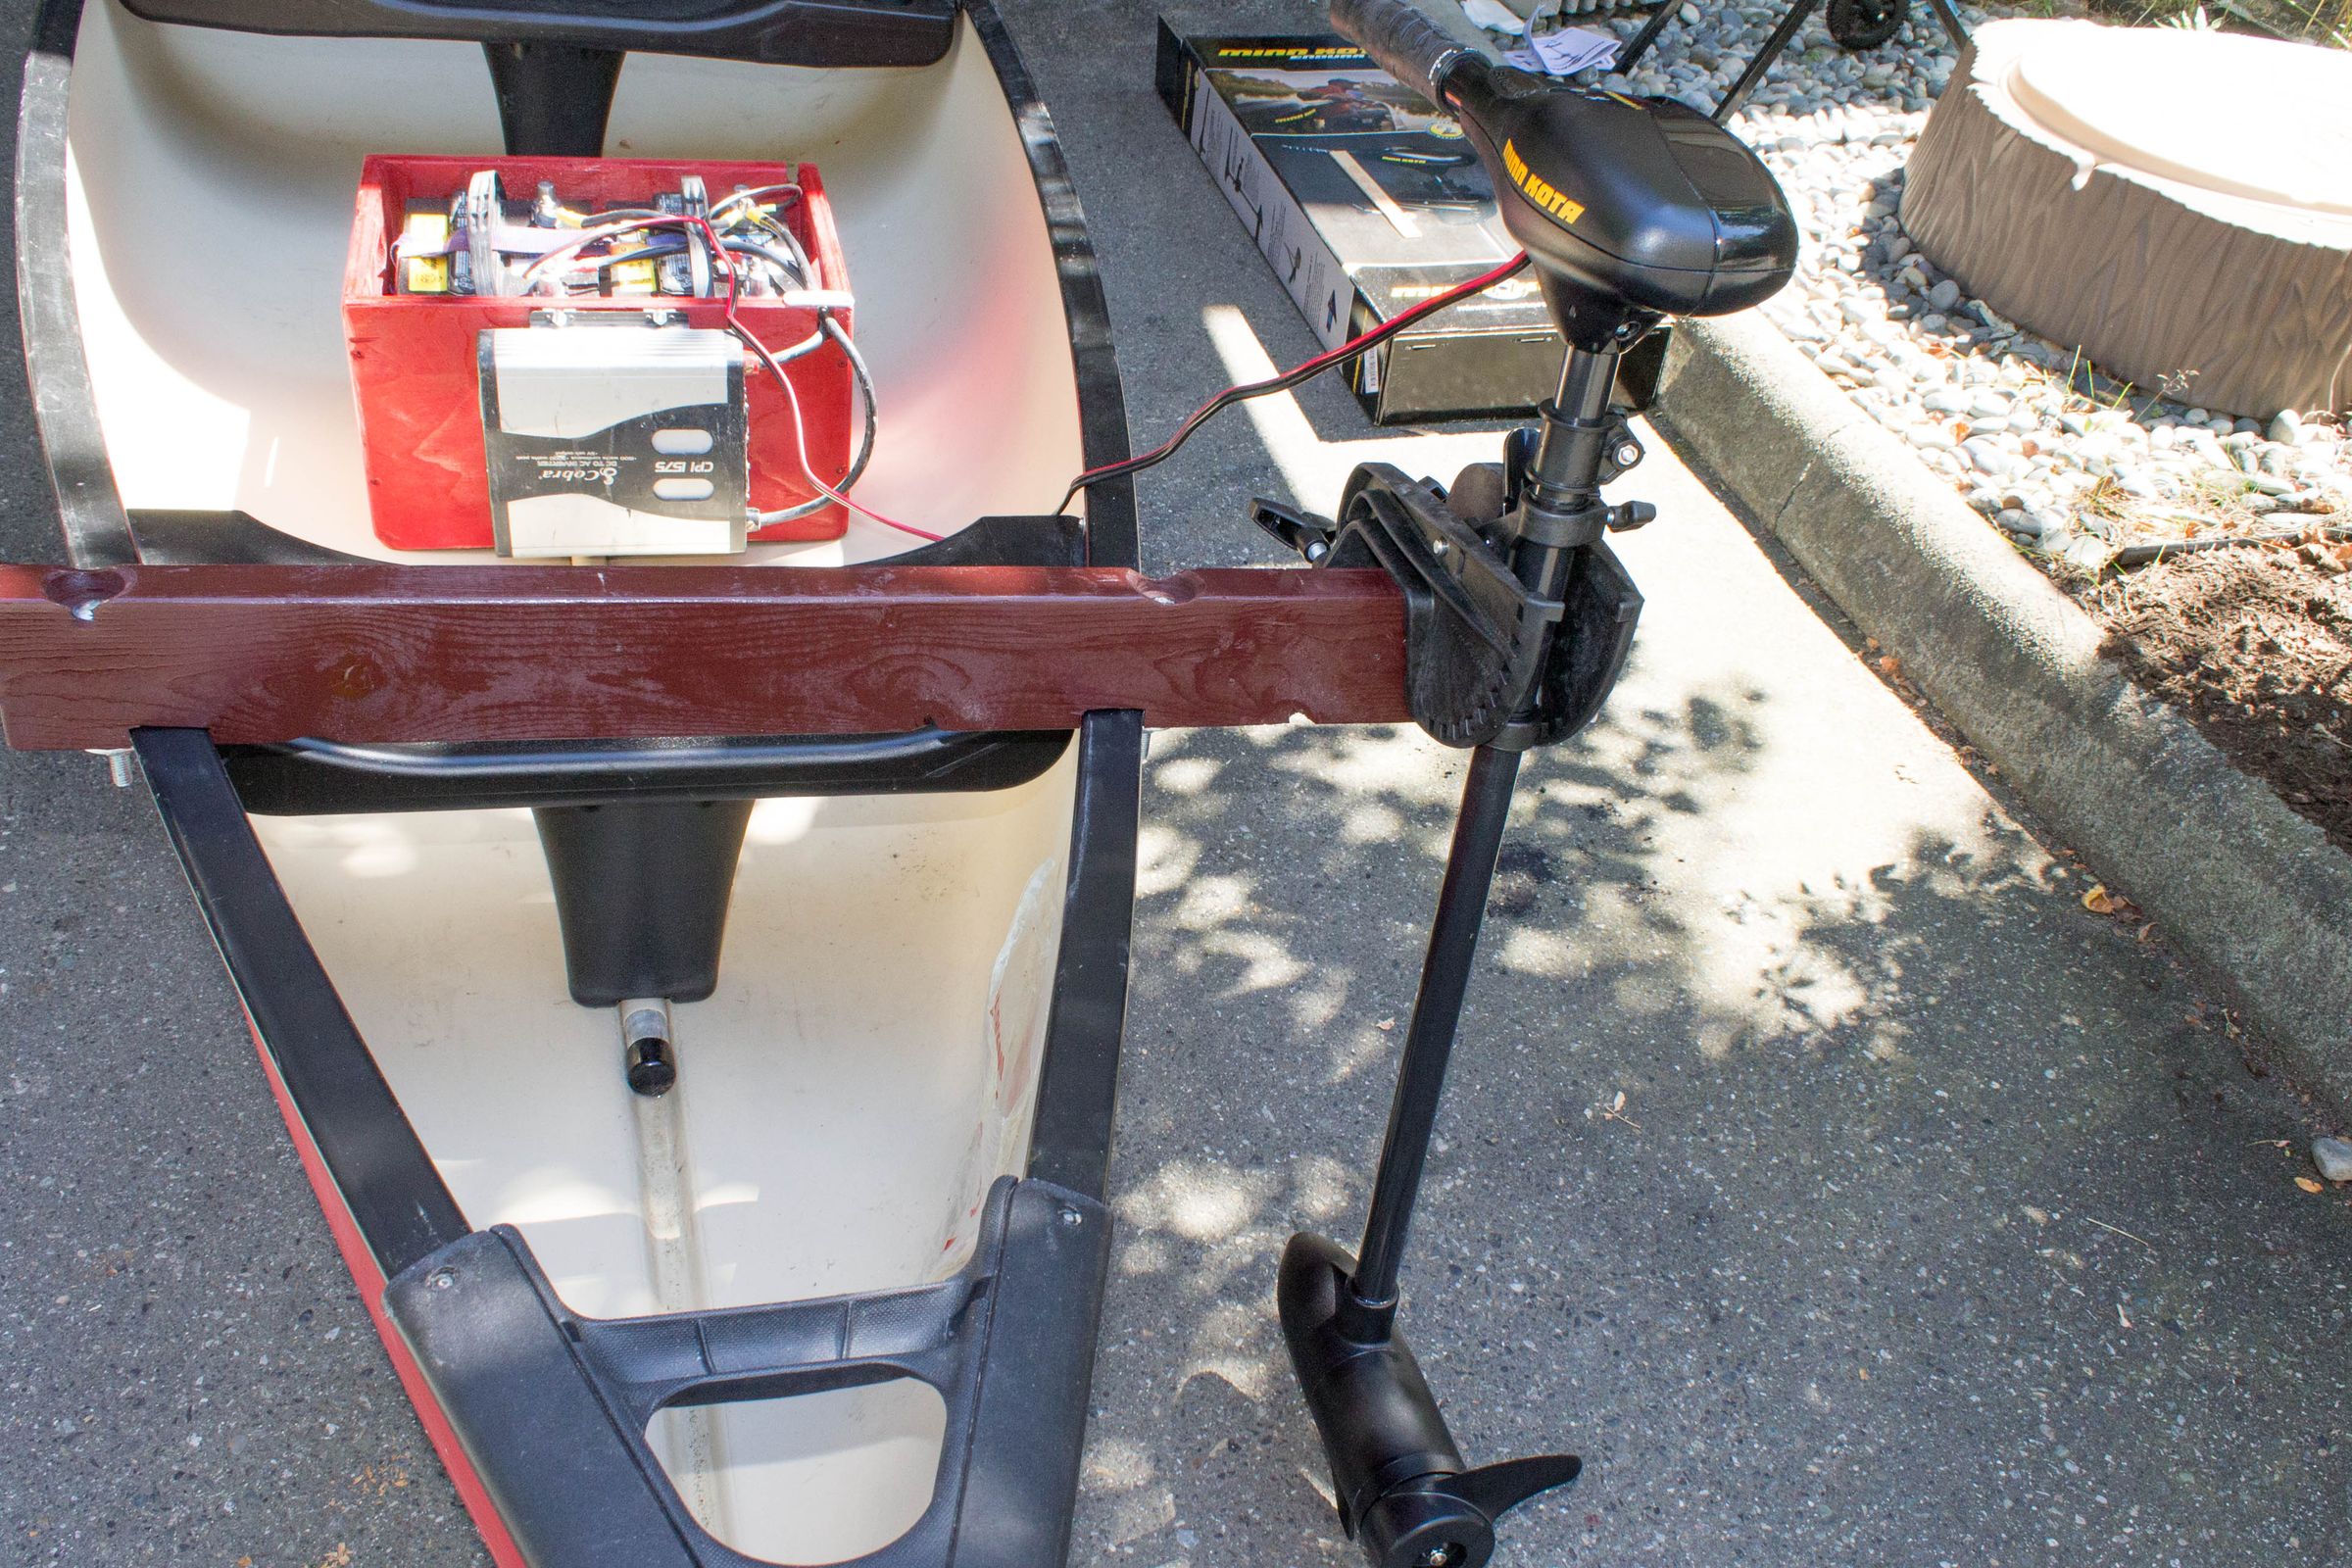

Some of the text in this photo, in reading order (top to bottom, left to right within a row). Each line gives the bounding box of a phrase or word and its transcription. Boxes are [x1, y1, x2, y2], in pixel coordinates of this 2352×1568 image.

[1218, 48, 1308, 57] MINN
[1523, 173, 1586, 224] KOTA
[690, 461, 714, 473] CPI
